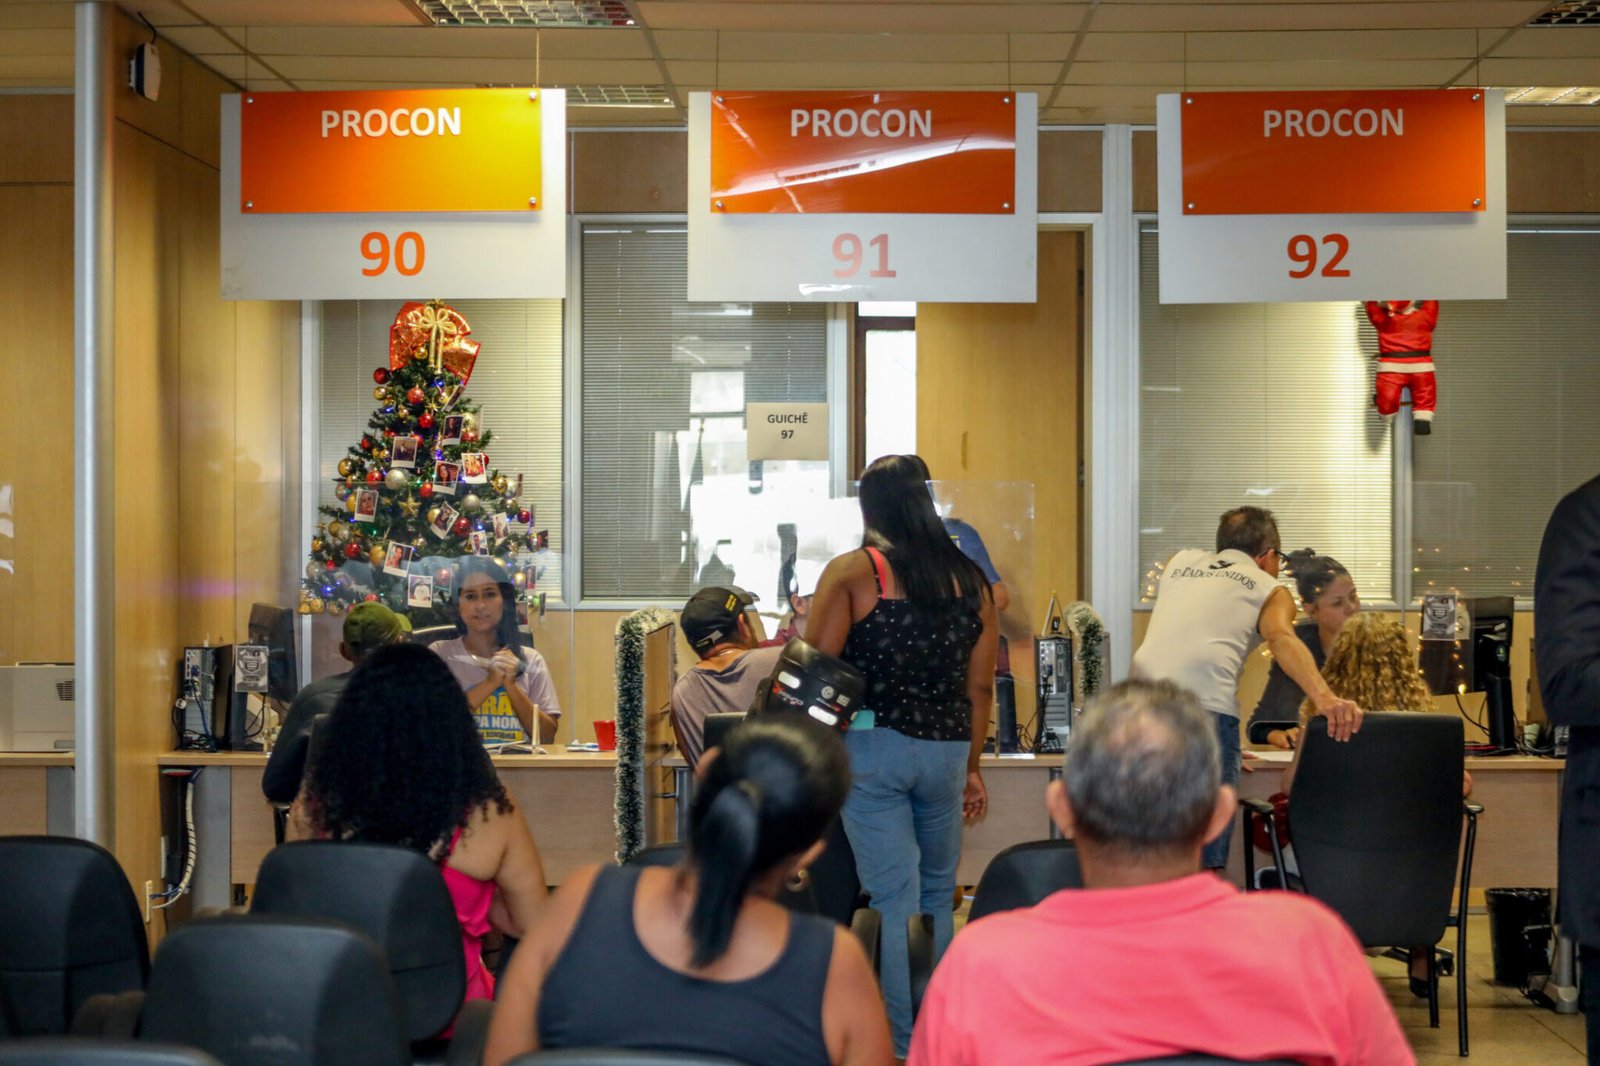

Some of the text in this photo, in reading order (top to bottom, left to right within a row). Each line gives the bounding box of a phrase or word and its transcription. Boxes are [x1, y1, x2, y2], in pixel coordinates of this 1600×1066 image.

[321, 107, 461, 138] PROCON
[790, 108, 932, 138] PROCON
[1263, 108, 1404, 138] PROCON
[360, 231, 426, 277] 90
[832, 232, 897, 278] 91
[1287, 233, 1351, 278] 92
[767, 412, 808, 424] GUICHÊ
[781, 430, 794, 440] 97
[1170, 566, 1257, 590] ETADOS UNIDOS
